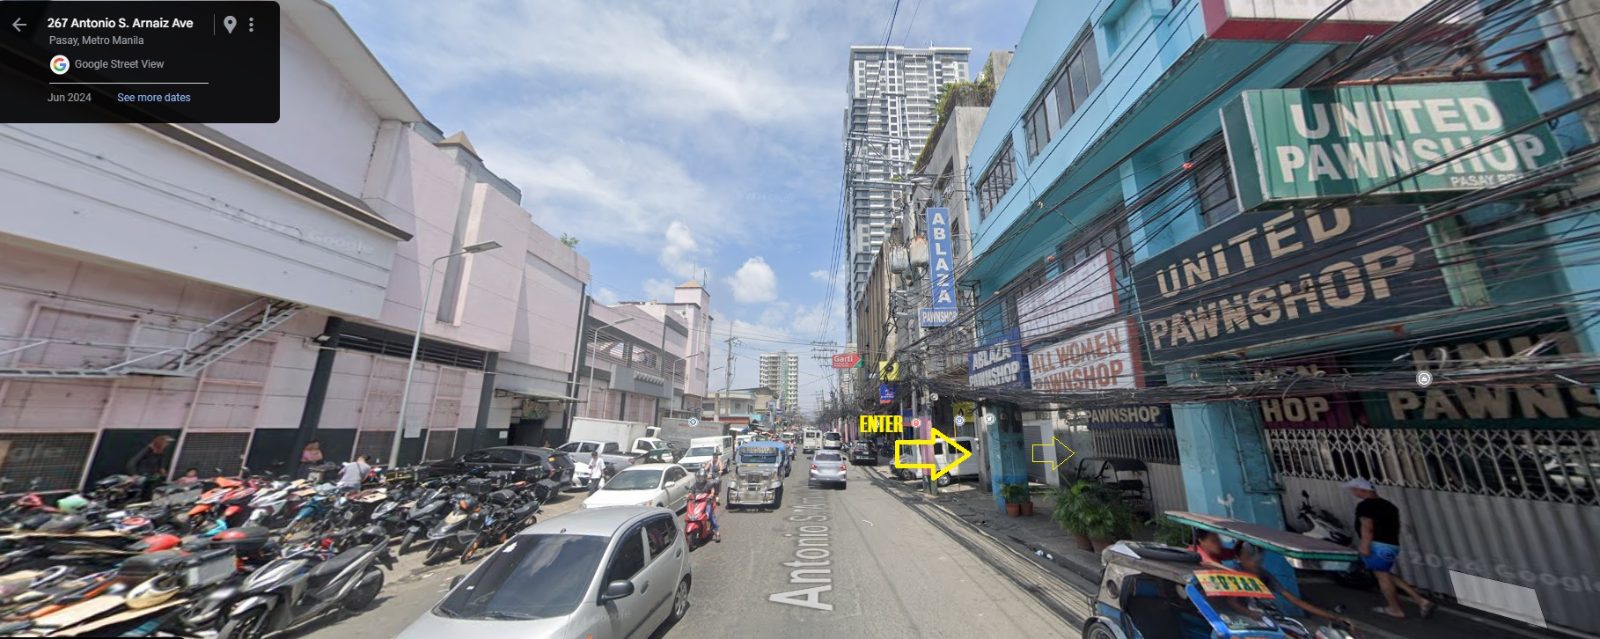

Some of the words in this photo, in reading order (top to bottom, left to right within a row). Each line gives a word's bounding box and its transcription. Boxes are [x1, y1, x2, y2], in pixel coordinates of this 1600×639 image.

[1289, 97, 1504, 140] UNITED
[1276, 132, 1546, 184] PAWNSHOP
[1450, 174, 1496, 189] PASAY
[932, 212, 952, 303] ABLAZA
[1156, 206, 1352, 299] UNITED
[1149, 245, 1416, 350] PAWNSHOP
[921, 311, 959, 324] PAWNSHOP
[973, 339, 1013, 371] ABLAZA
[1031, 350, 1056, 375] ALL
[1056, 327, 1122, 369] WOMEN
[969, 360, 1020, 390] PAWNSHOP
[1034, 358, 1125, 390] PAWNSHOP
[1085, 405, 1161, 424] PAWNSHOP
